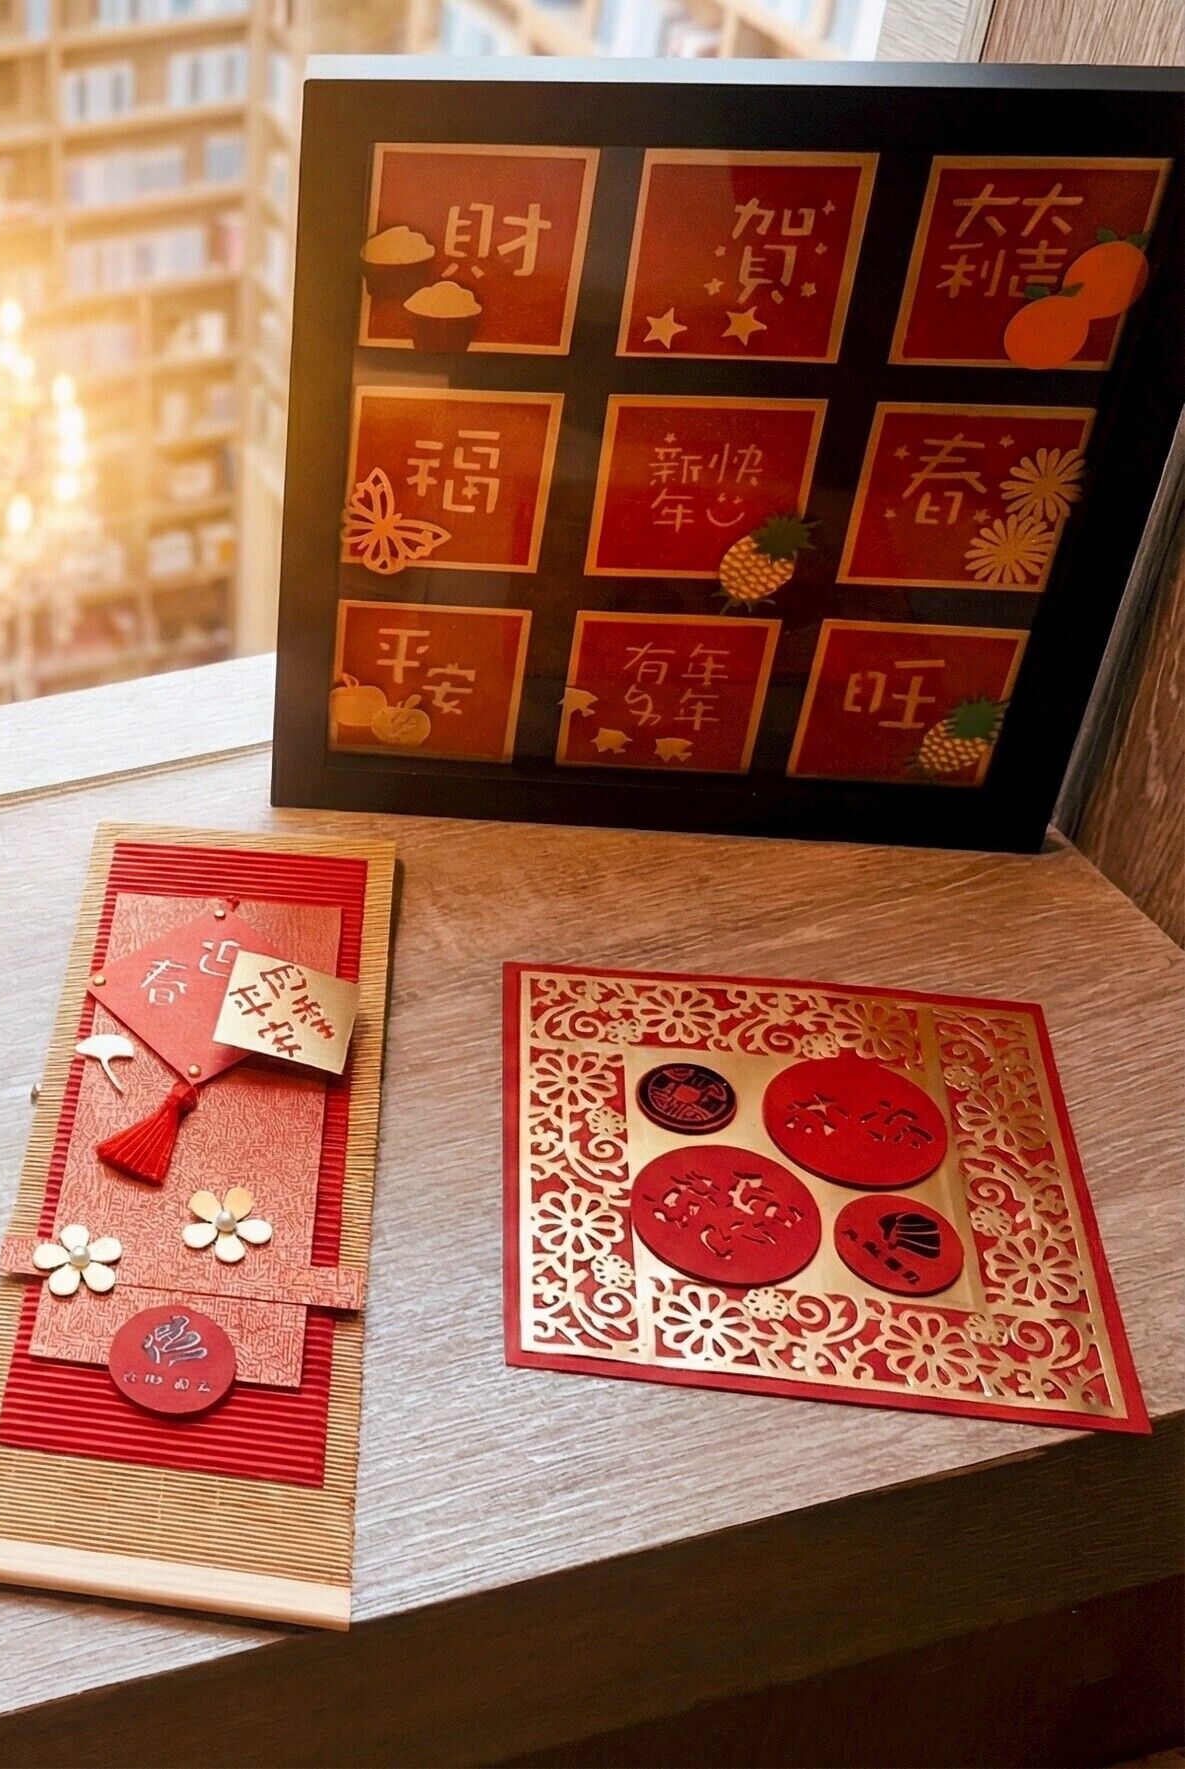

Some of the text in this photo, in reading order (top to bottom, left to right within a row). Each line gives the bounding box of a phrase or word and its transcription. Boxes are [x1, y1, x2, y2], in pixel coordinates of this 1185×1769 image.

[441, 203, 552, 279] 財
[732, 197, 815, 304] 賀
[406, 429, 500, 514] 福
[902, 433, 987, 524] 春
[843, 659, 945, 730] 旺
